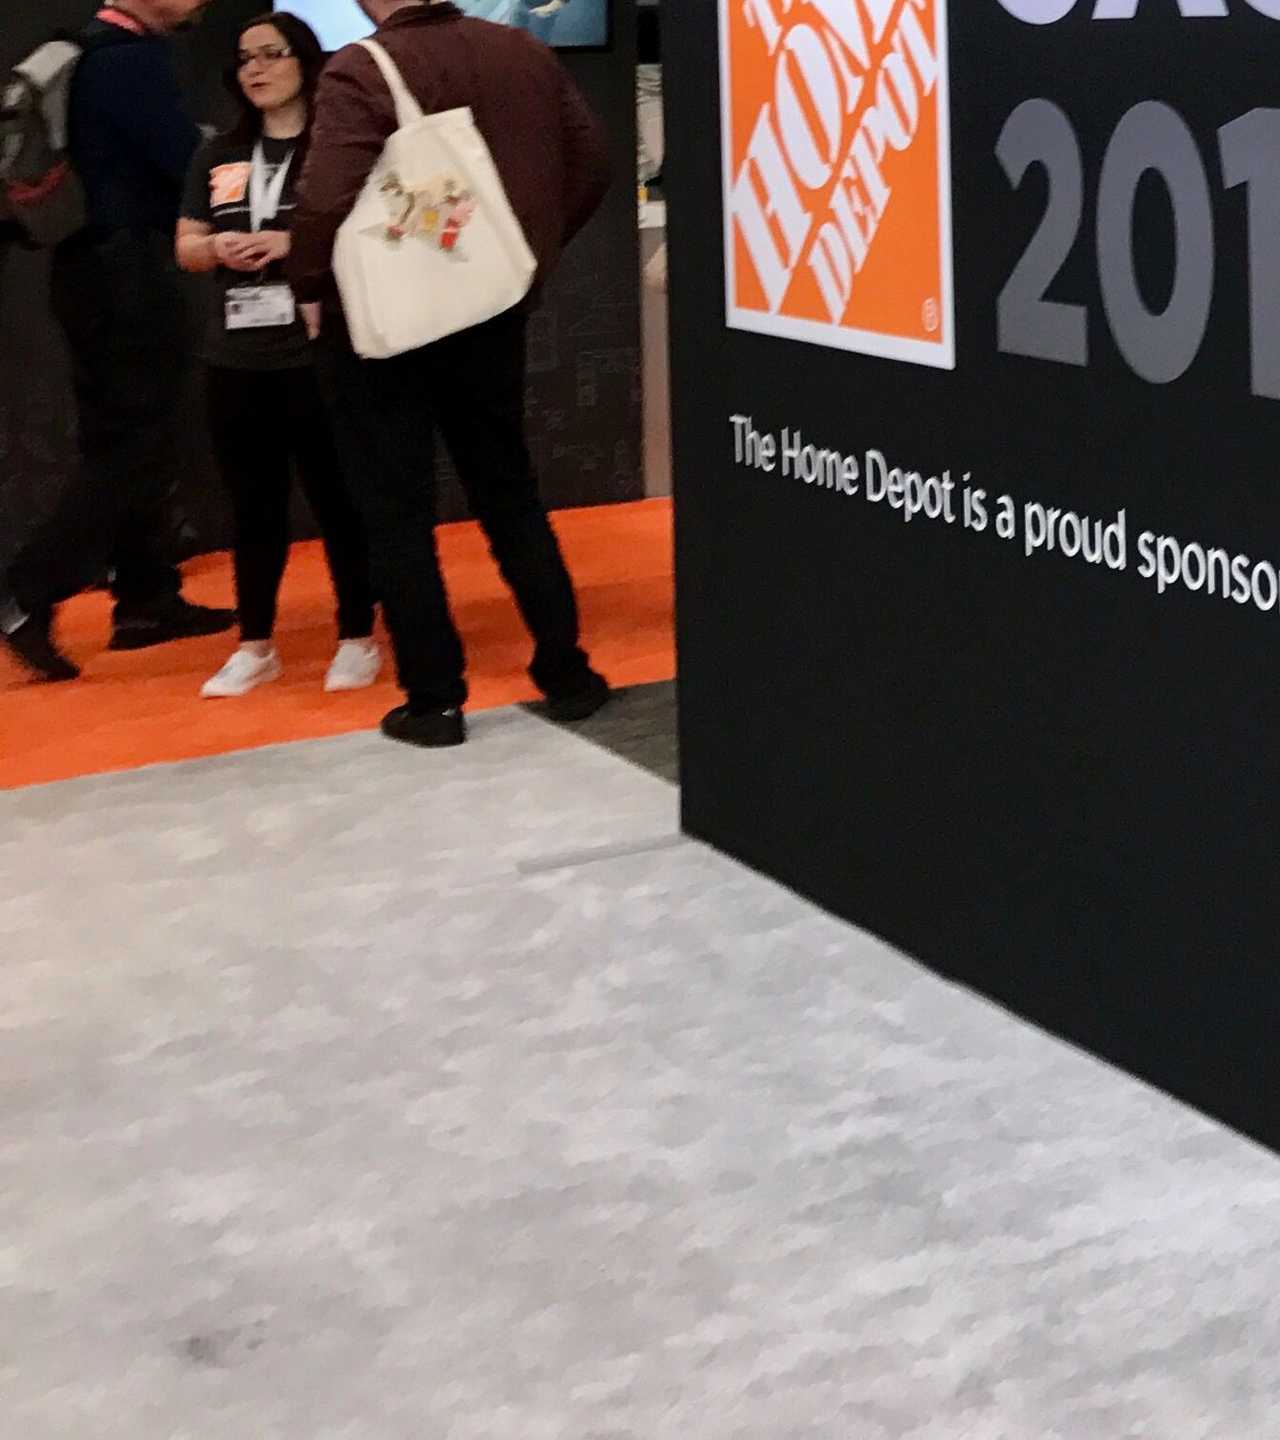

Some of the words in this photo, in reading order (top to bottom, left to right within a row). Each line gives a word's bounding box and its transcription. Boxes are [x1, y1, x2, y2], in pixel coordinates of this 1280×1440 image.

[730, 414, 775, 472] The
[781, 427, 859, 495] Home
[866, 450, 955, 522] Depot
[963, 472, 988, 531] is
[996, 495, 1015, 538] a
[1025, 508, 1126, 571] proud
